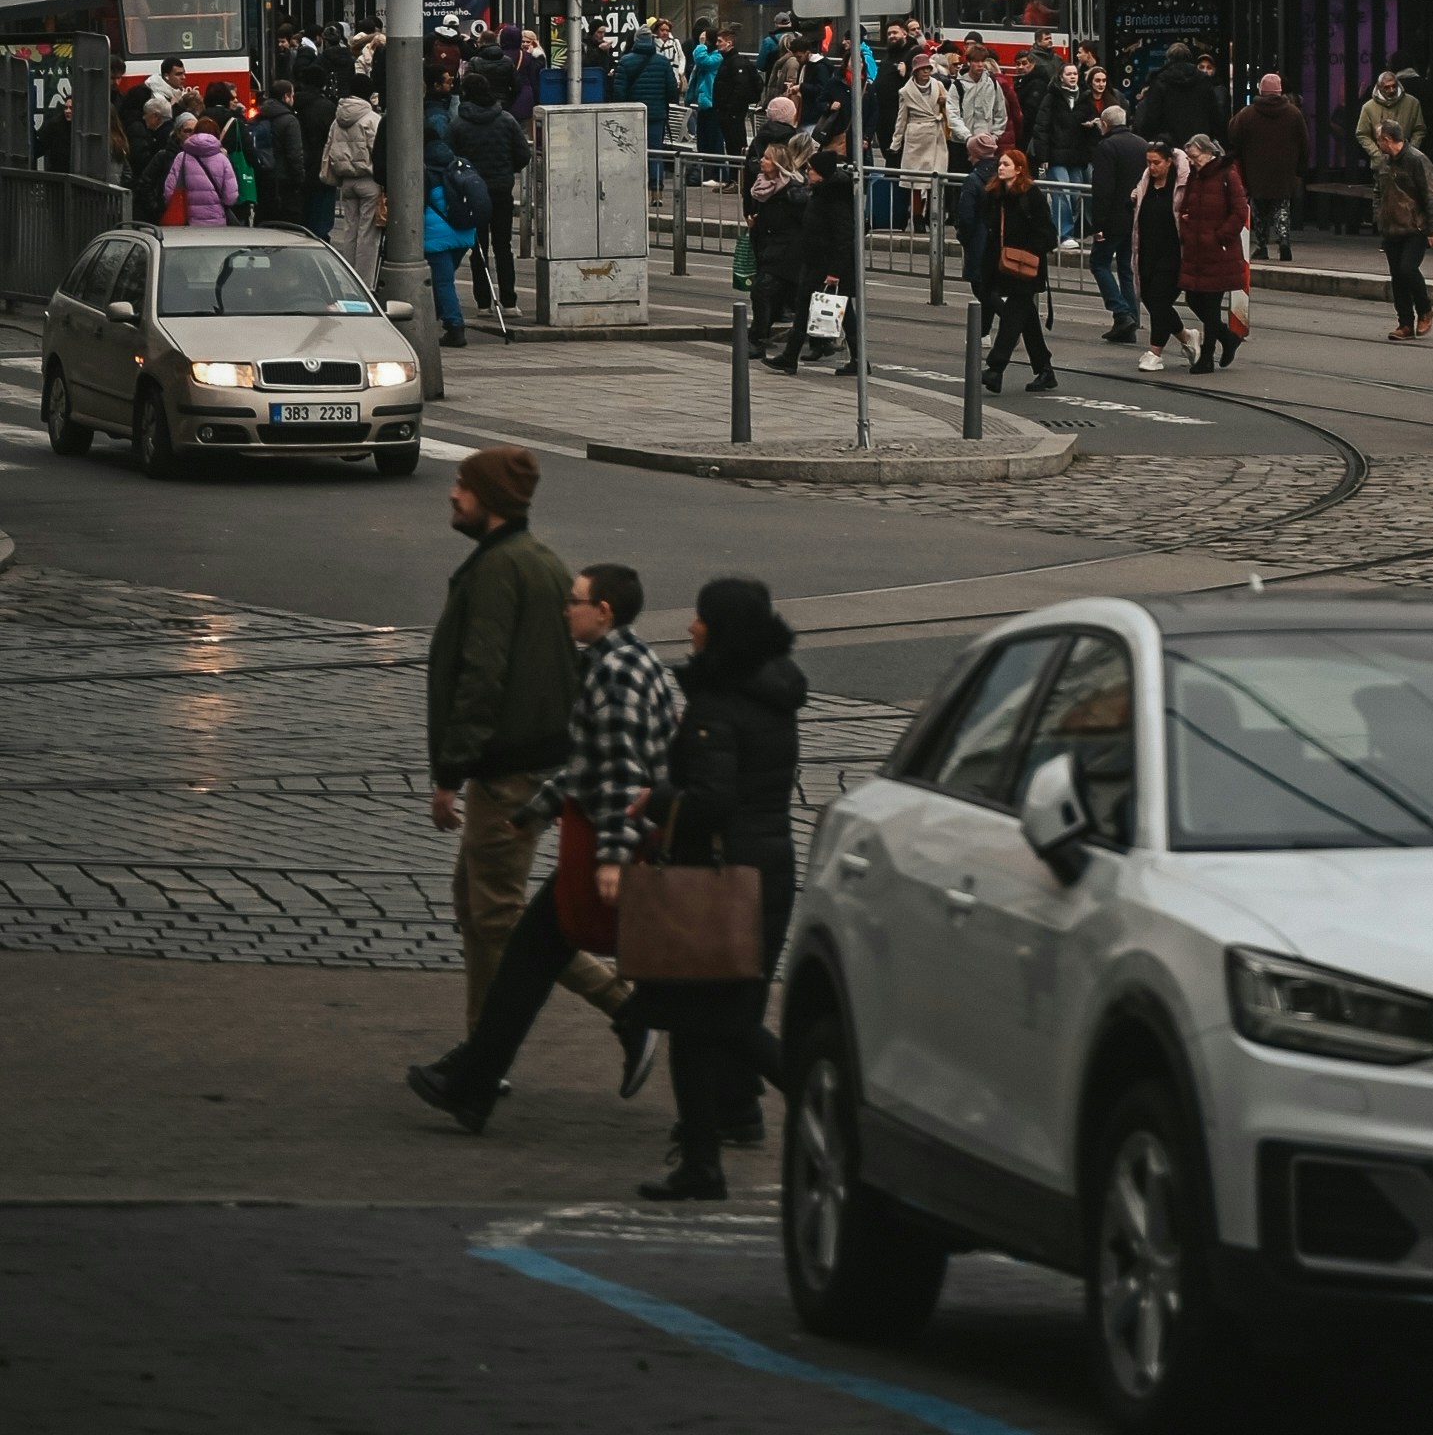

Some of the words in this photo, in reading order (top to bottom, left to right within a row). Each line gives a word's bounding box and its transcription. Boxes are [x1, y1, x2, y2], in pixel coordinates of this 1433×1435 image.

[1125, 13, 1171, 26] Brněnské
[1173, 12, 1210, 25] Vánoce
[284, 406, 310, 421] 3B3
[319, 406, 353, 421] 2238
